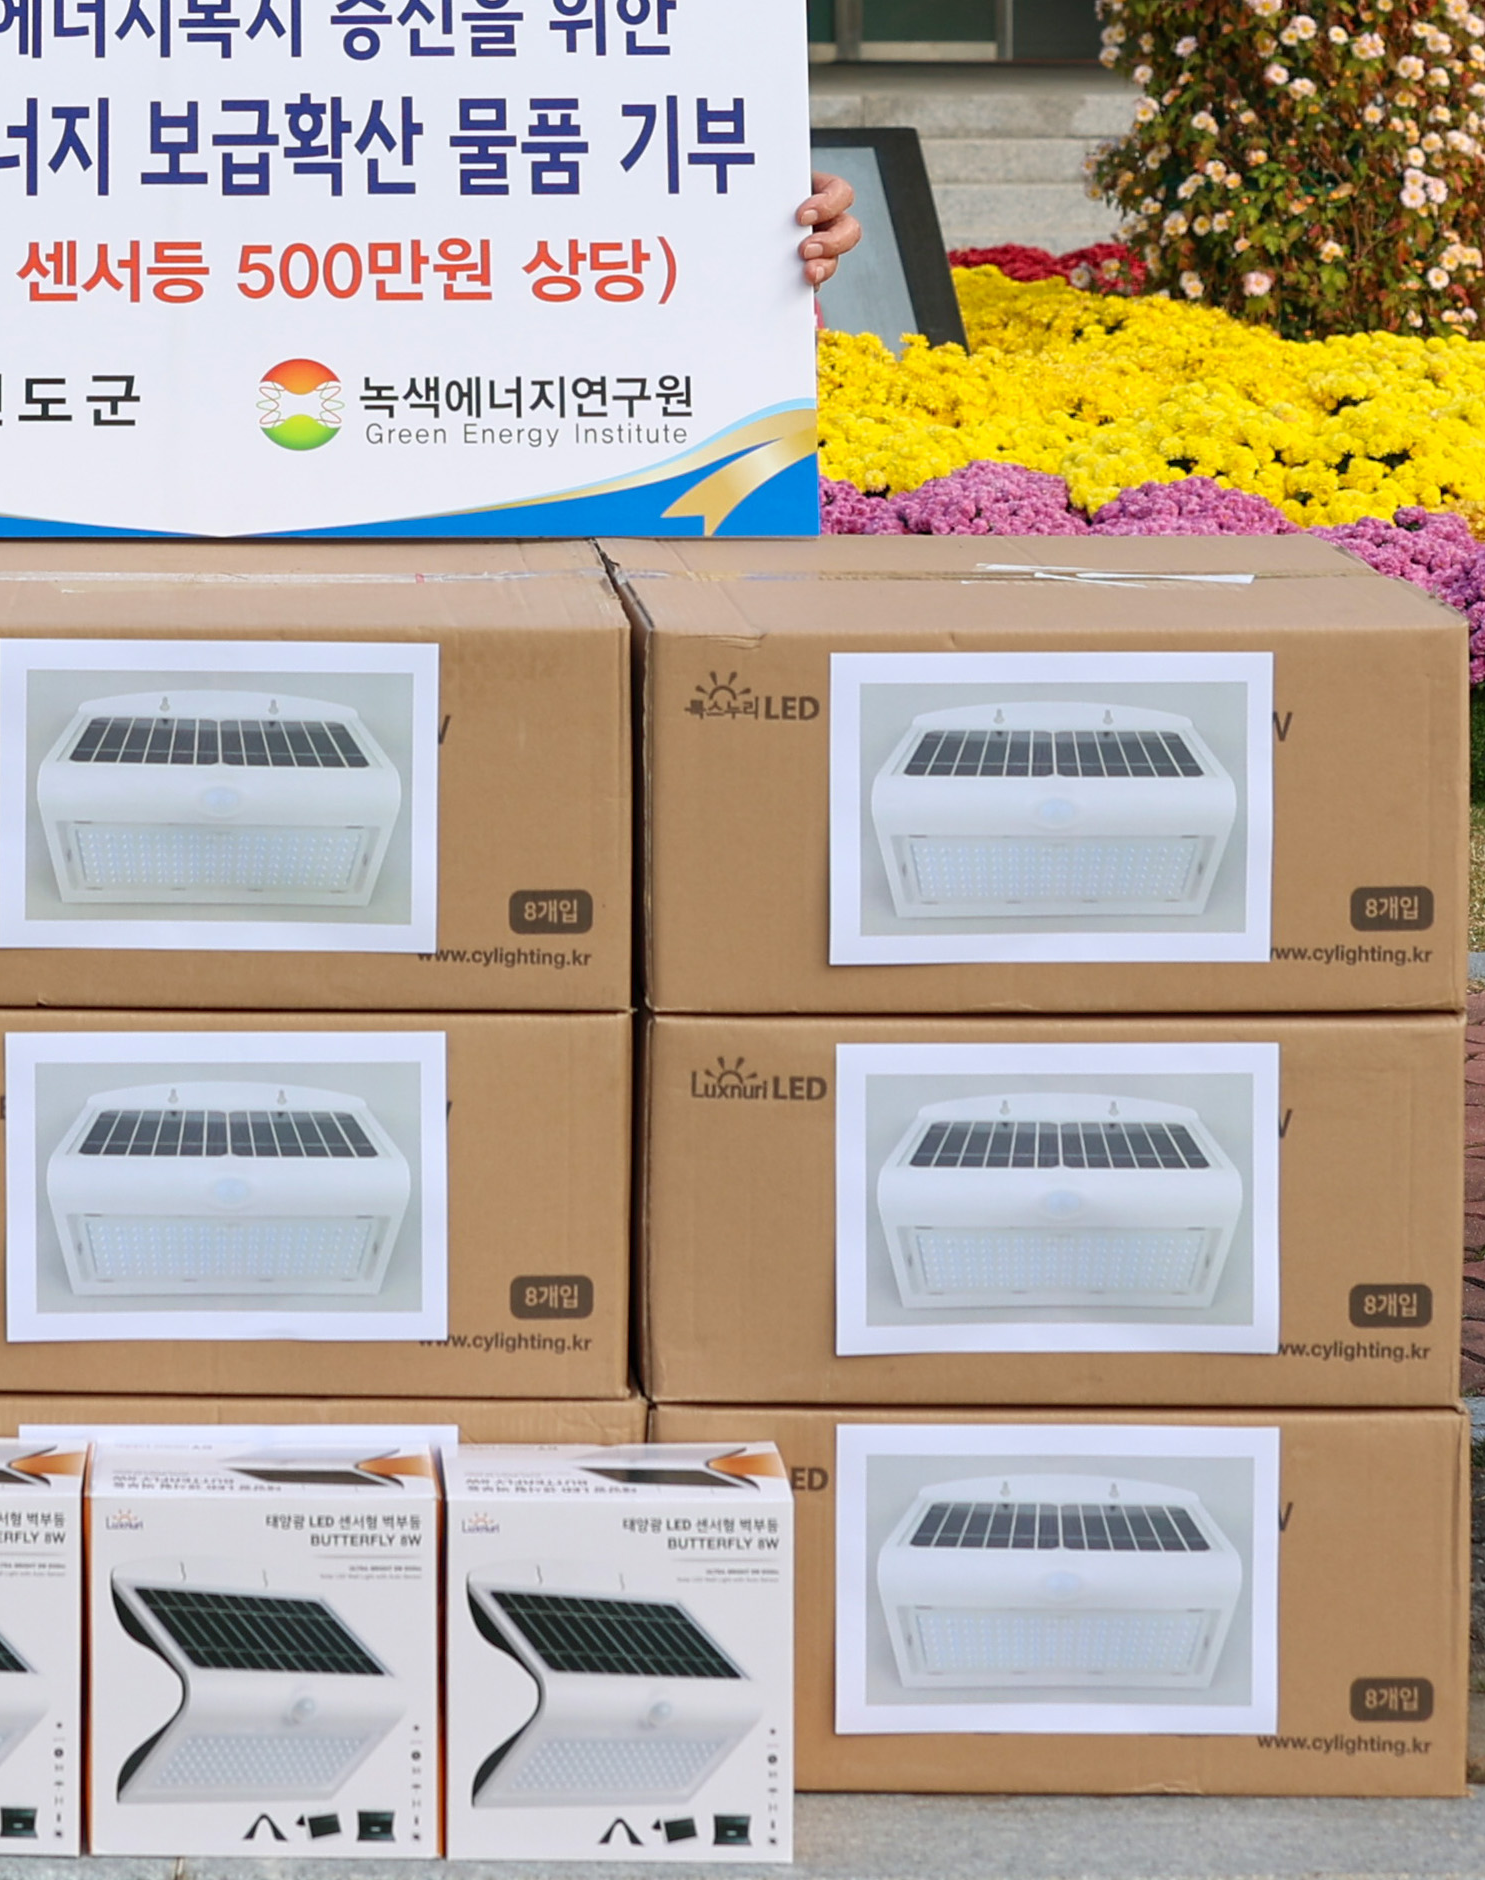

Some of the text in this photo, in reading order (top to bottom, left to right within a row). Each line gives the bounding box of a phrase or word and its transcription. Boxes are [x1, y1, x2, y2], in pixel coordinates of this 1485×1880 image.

[140, 92, 423, 198] 보급확산
[449, 96, 588, 197] 물품
[618, 96, 757, 196] 기부
[16, 239, 212, 304] 센서등
[236, 237, 494, 303] 500만원
[521, 235, 679, 305] 상당)
[359, 374, 694, 419] 녹색에너지연구원
[365, 422, 688, 448] Green Energy Institute
[764, 696, 821, 721] LED
[522, 899, 578, 926] 8개입
[1363, 895, 1420, 922] 8개입
[690, 1070, 828, 1101] Luxnuri LED
[523, 1284, 580, 1311] 8개입
[1362, 1293, 1419, 1320] 8개입
[791, 1467, 829, 1491] ED
[265, 1514, 305, 1530] 태양광
[308, 1516, 335, 1529] LED
[338, 1514, 378, 1530] 센서형
[623, 1517, 662, 1533] 태양광
[666, 1519, 692, 1532] LED
[696, 1517, 735, 1533] 센서형
[43, 1531, 66, 1544] 8W
[310, 1533, 422, 1547] BUTTERFLY 8W
[667, 1536, 780, 1550] BUTTERFLY 8W
[1363, 1687, 1420, 1712] 8개입
[1257, 1736, 1430, 1756] www.cylighting.kr
